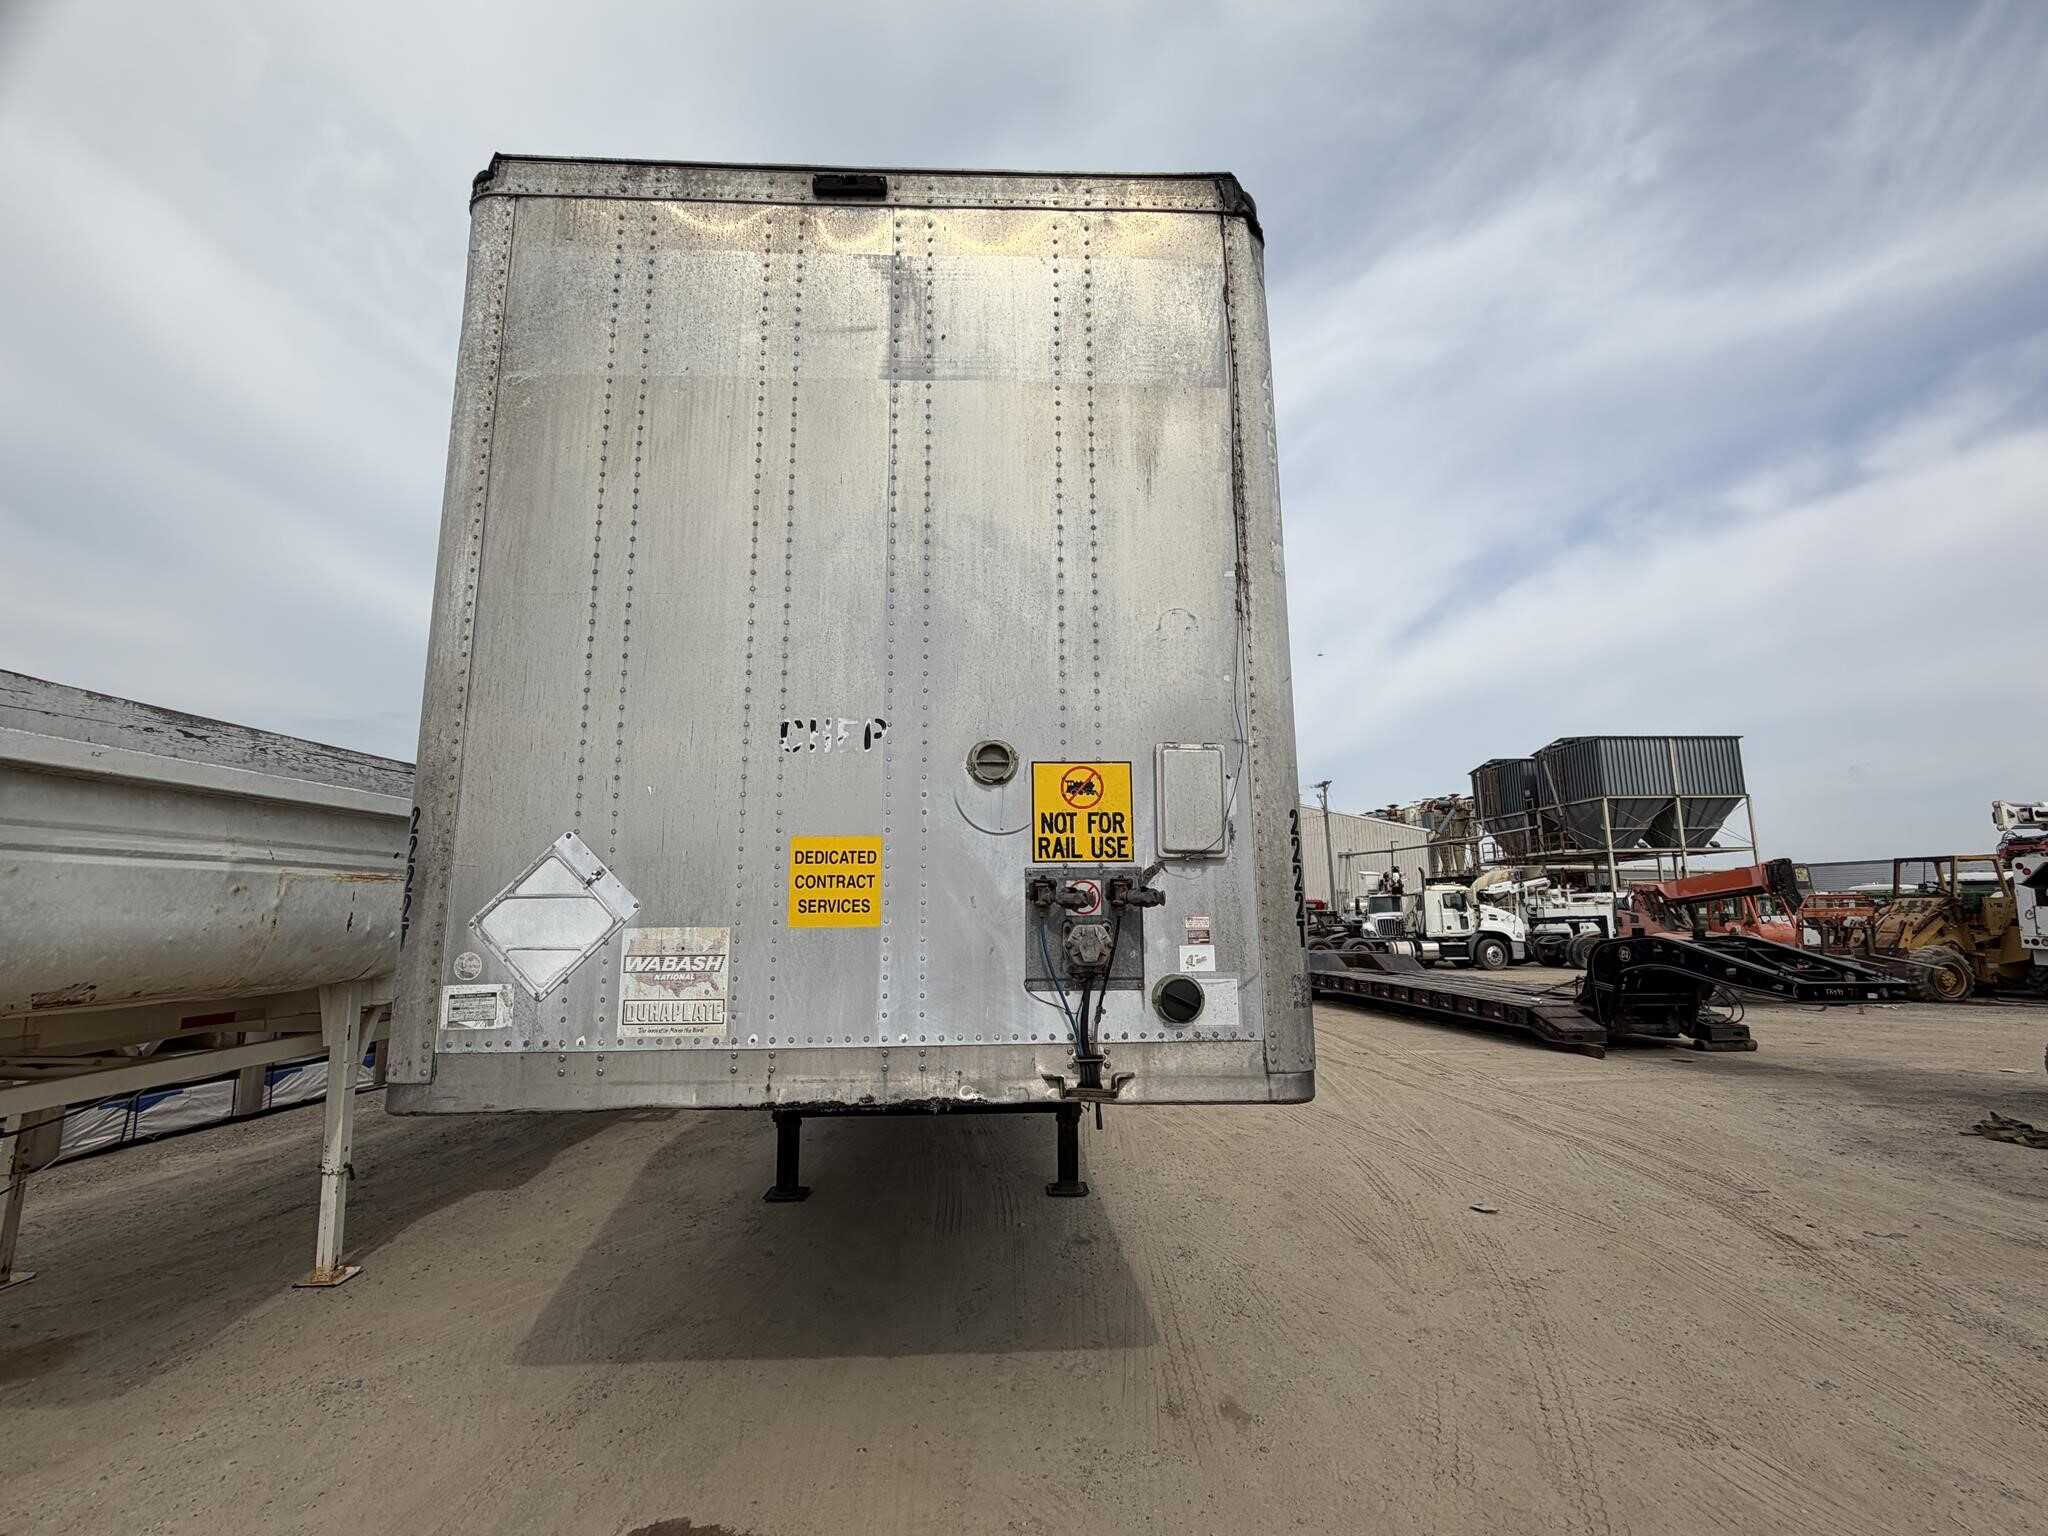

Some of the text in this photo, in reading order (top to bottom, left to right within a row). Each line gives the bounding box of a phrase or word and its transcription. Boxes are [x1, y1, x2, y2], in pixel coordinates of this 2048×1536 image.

[1040, 811, 1126, 834] NOT FOR
[1037, 836, 1130, 859] RAIL USE
[794, 850, 877, 865] DEDICATED
[794, 874, 876, 889] CONTRACT
[797, 898, 871, 914] SERVICES
[624, 955, 722, 972] WABASH
[625, 1001, 722, 1023] DURAPLATE
